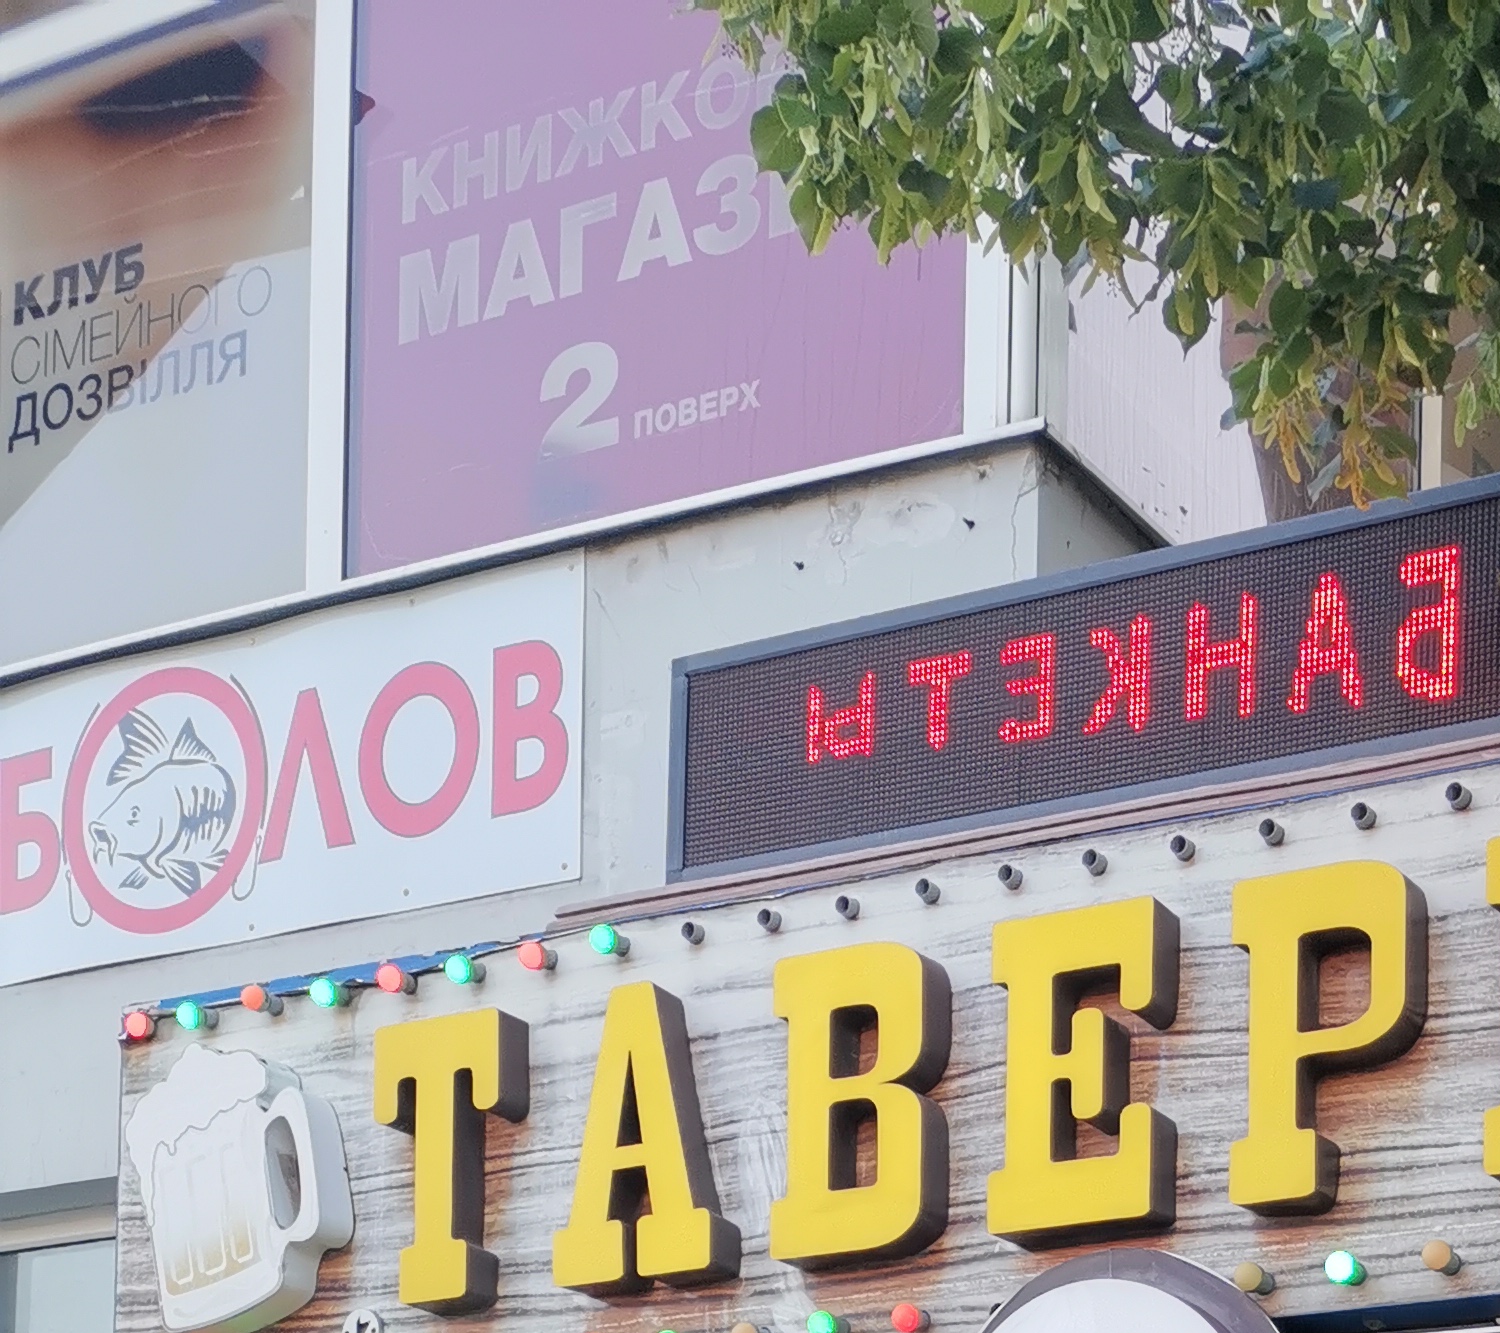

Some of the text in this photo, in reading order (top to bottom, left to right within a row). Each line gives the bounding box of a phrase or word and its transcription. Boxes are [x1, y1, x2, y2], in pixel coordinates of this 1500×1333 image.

[401, 55, 775, 225] КНИЖКО
[10, 265, 272, 385] СІМЕЙНОГО
[14, 243, 145, 325] КЛУБ
[7, 330, 249, 451] ДОЗВІЛЛЯ
[539, 341, 762, 458] 2 ПОВЕРХ
